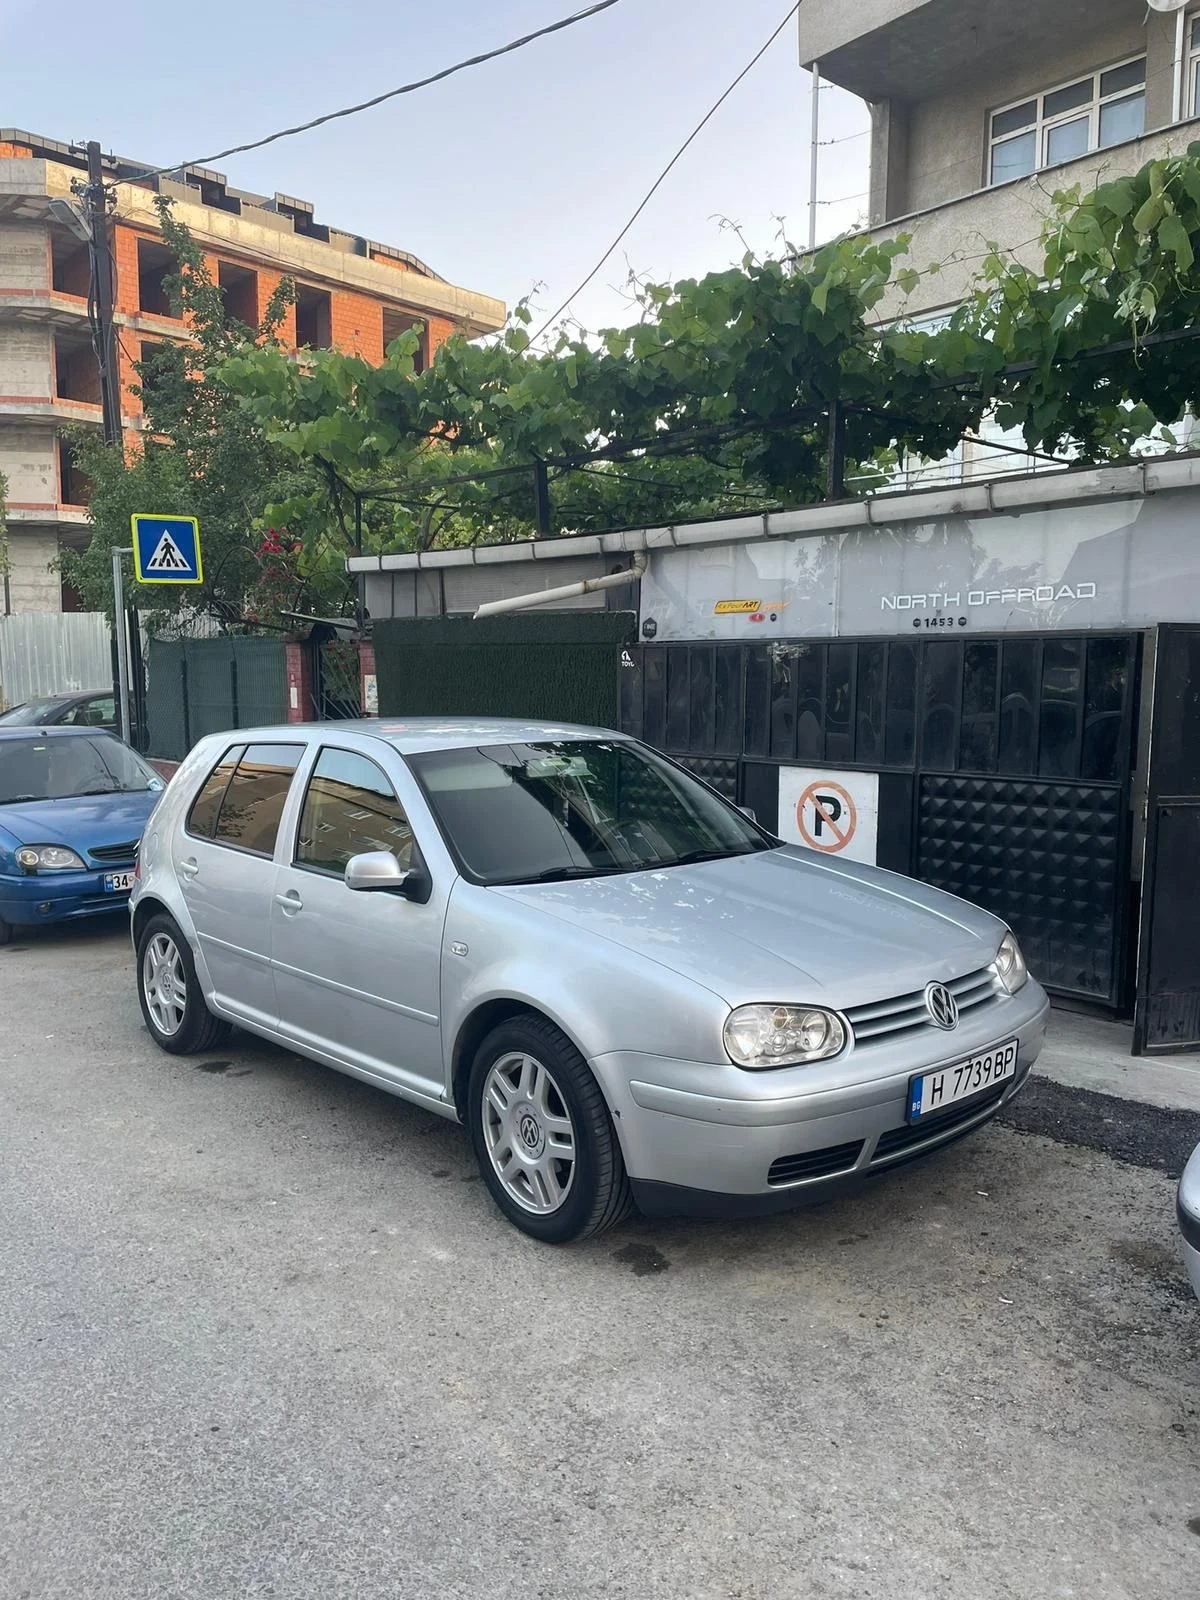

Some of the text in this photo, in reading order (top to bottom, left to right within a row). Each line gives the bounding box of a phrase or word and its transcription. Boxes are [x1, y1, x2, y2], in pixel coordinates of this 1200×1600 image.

[881, 583, 1096, 610] NORTH OFFROAD
[924, 617, 954, 628] 1453
[814, 795, 841, 837] P
[113, 875, 128, 888] 34
[931, 1074, 944, 1105] H
[912, 1100, 921, 1112] BG
